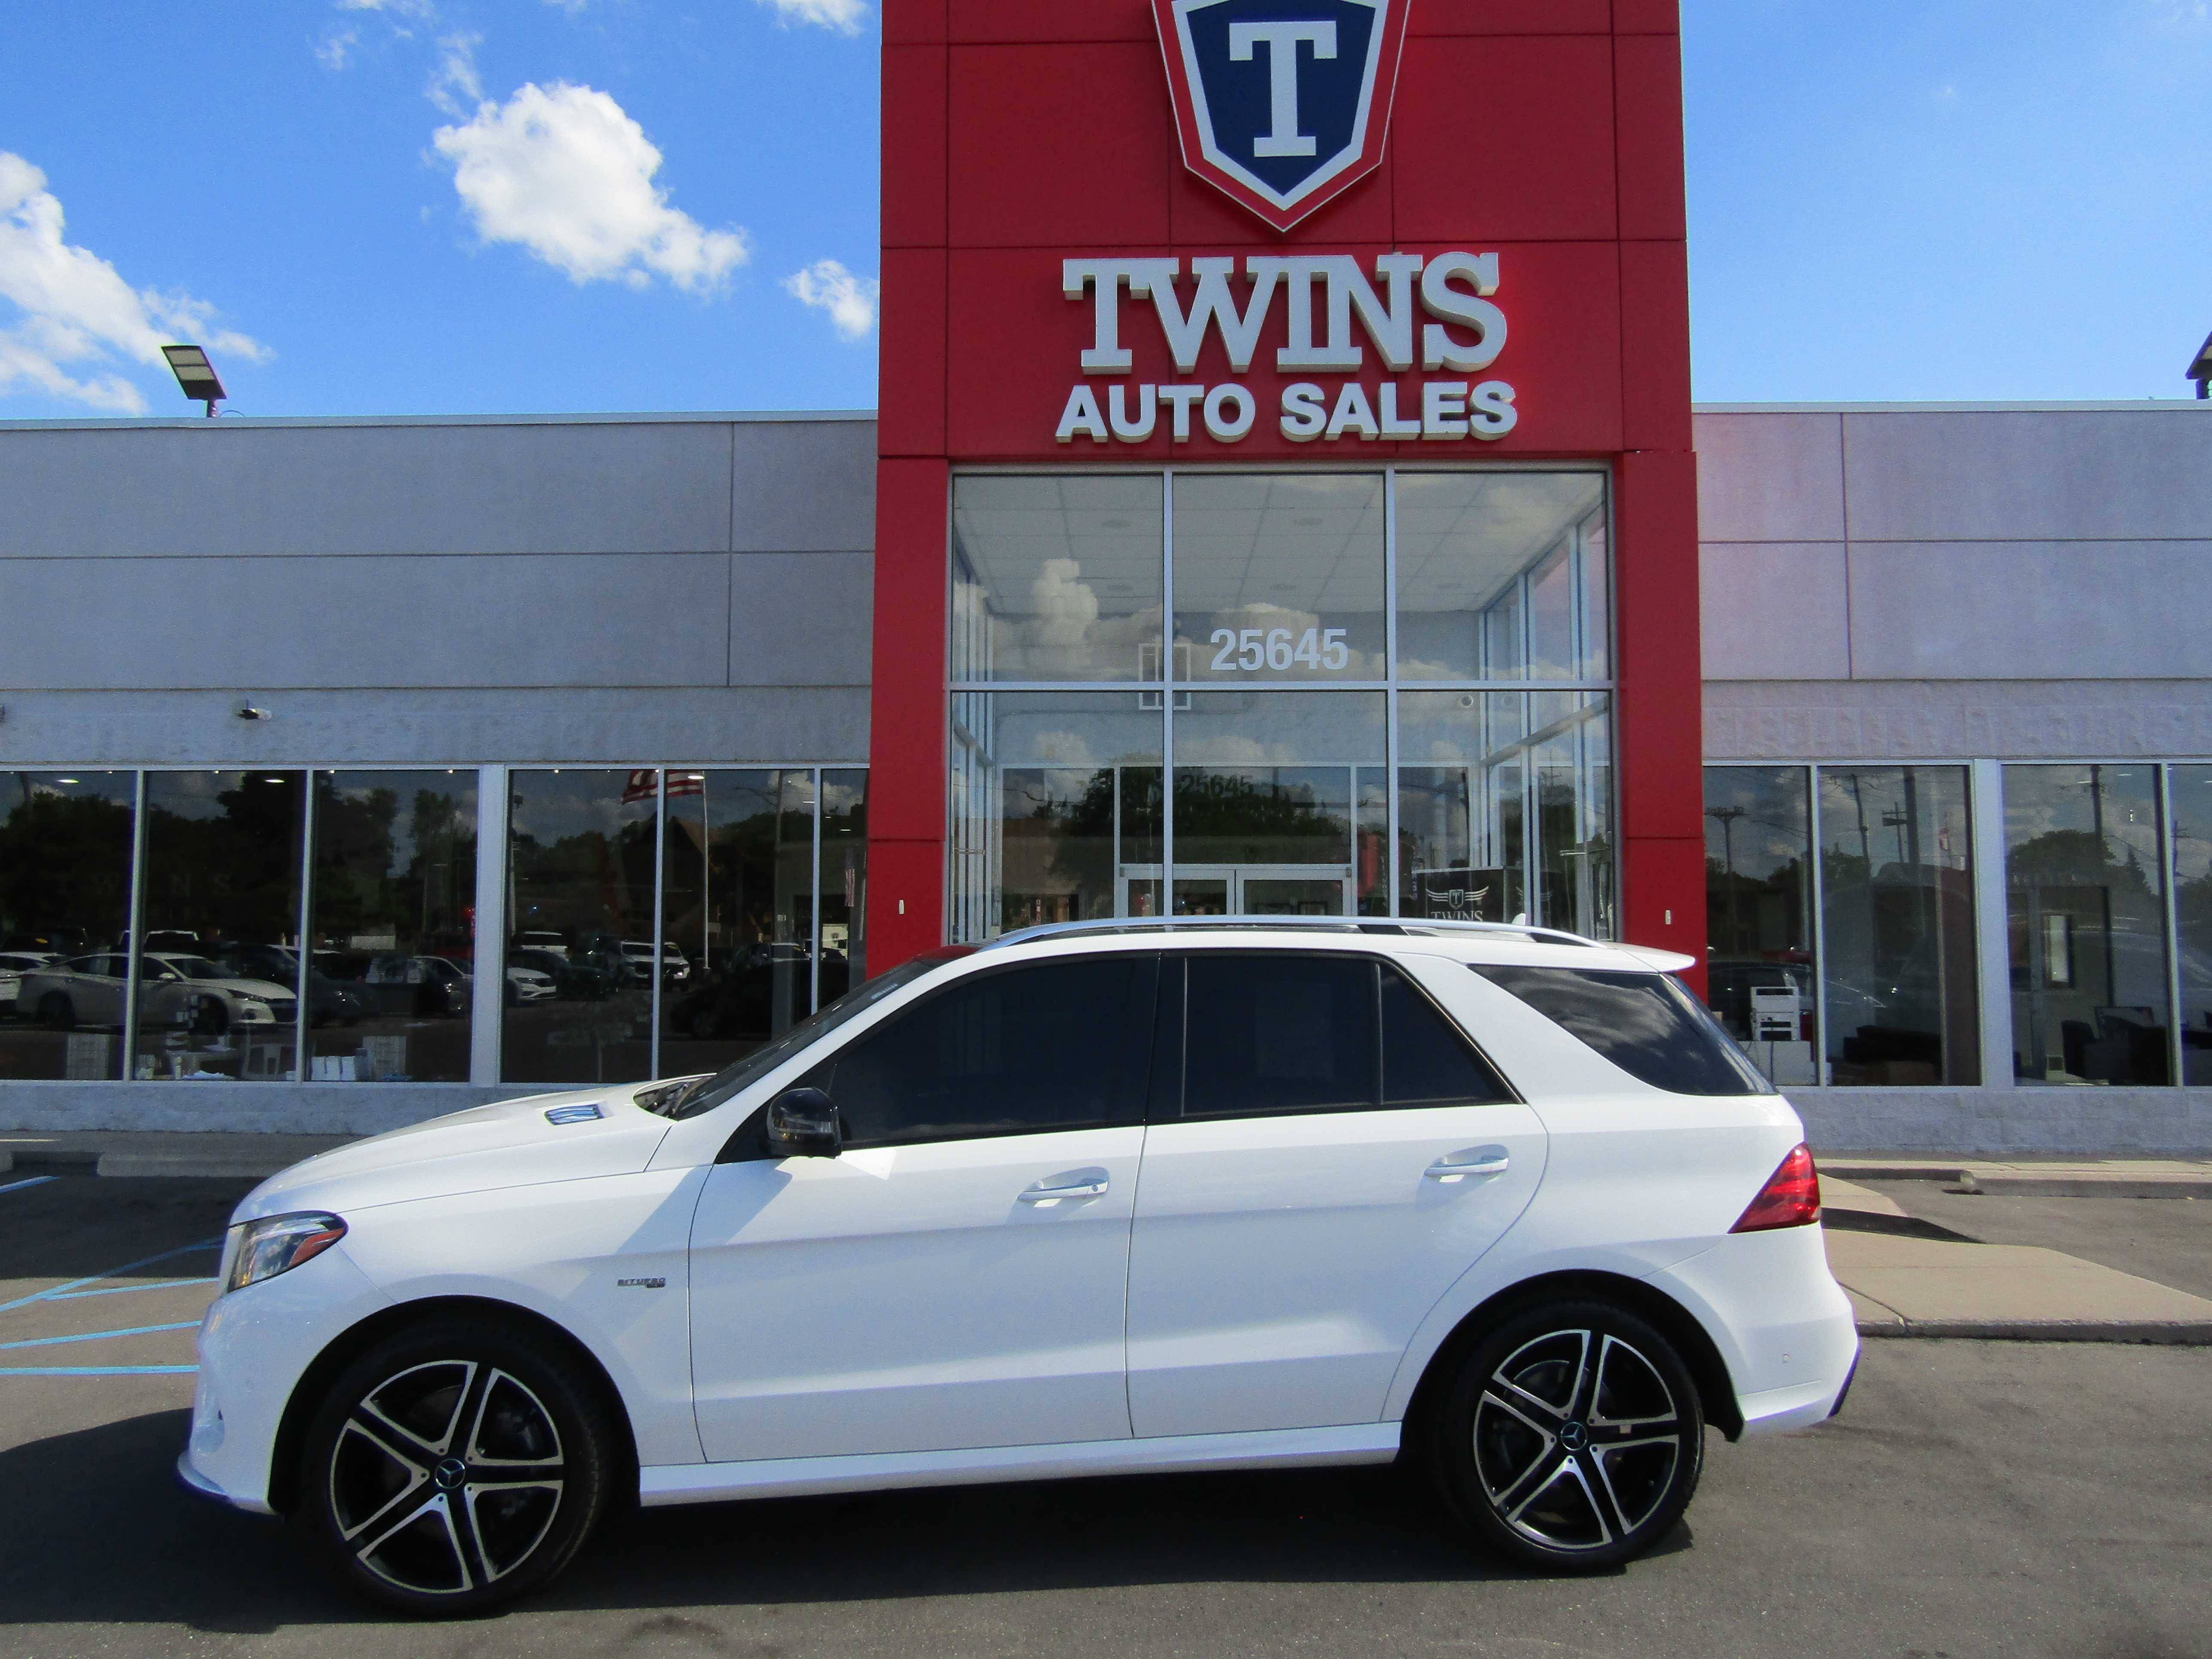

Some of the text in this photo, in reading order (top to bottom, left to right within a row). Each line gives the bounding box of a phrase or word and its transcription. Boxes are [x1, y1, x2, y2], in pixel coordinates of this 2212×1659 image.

[1229, 21, 1337, 157] T
[1063, 251, 1507, 374] TWINS
[1055, 380, 1518, 443] AUTO SALES
[1211, 628, 1349, 671] 25645
[1431, 910, 1483, 921] TWINS
